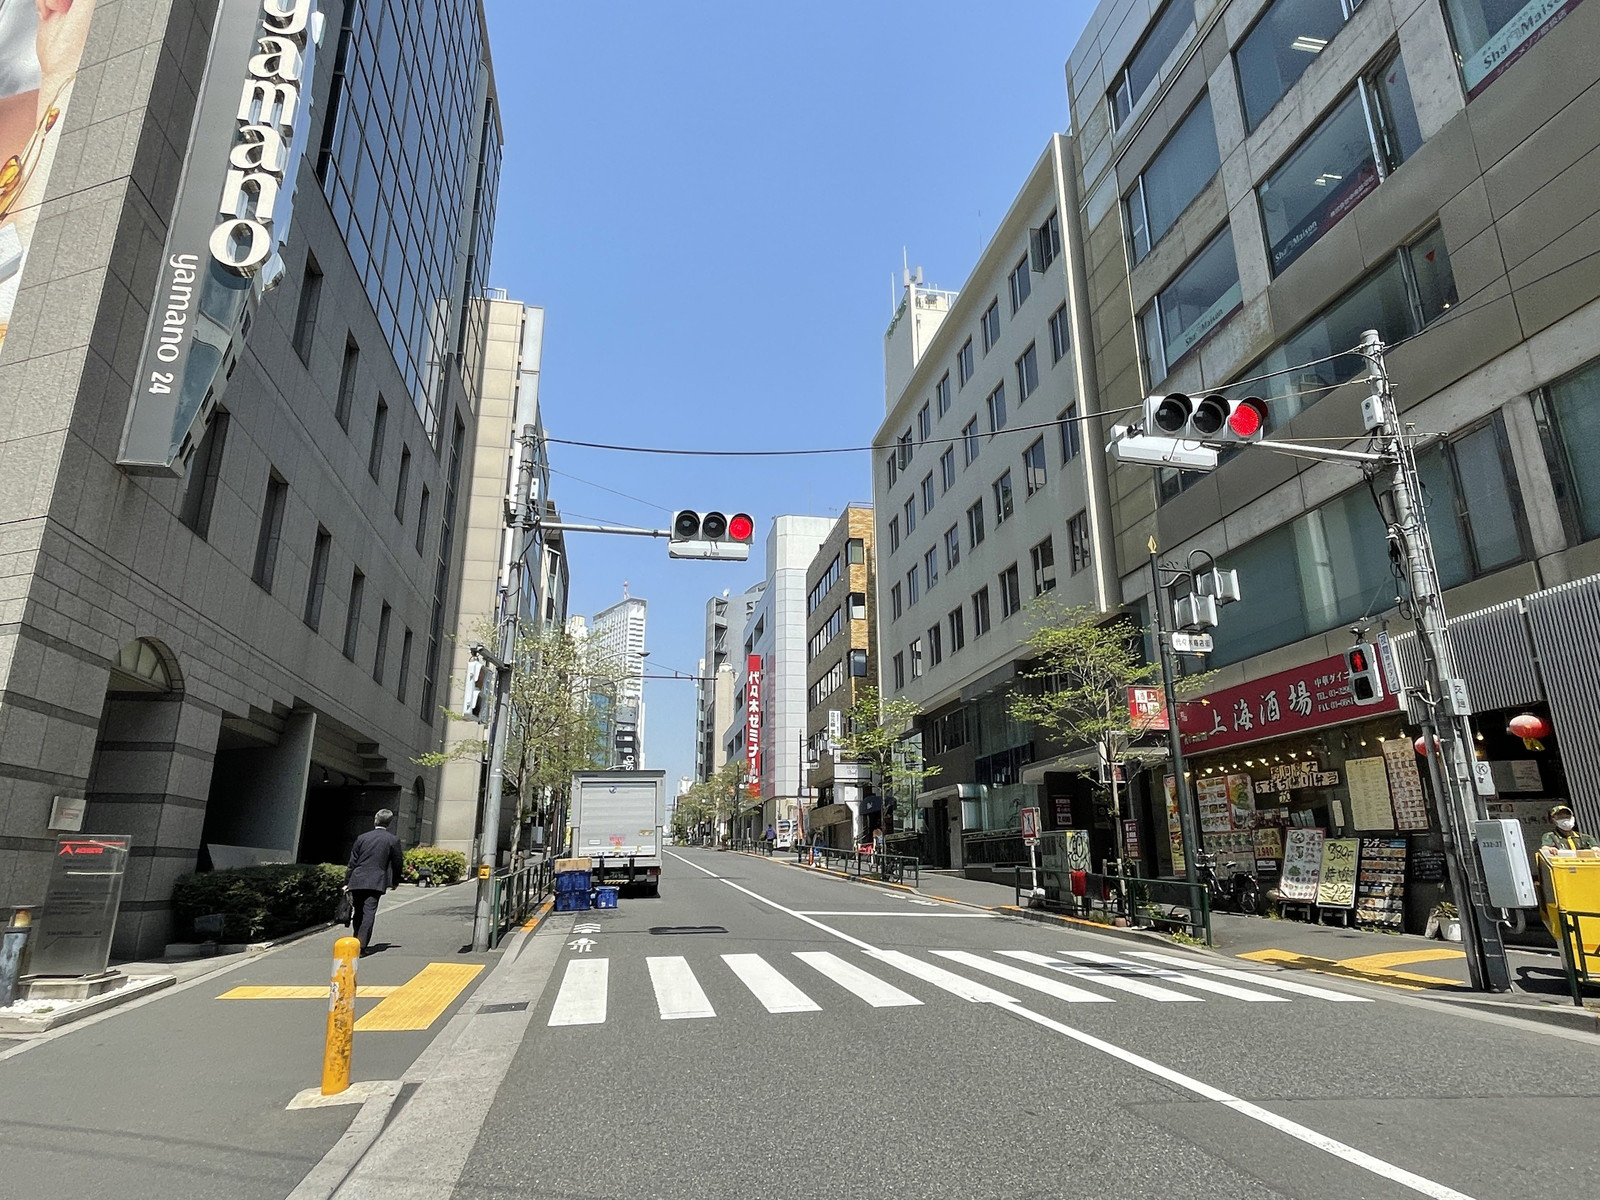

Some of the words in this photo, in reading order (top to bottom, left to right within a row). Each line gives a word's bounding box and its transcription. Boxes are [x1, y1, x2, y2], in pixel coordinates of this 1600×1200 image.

[155, 253, 199, 363] yamano
[149, 371, 174, 396] 24
[748, 670, 759, 785] 代々木ゼミナール
[1209, 680, 1313, 736] 上海酒場
